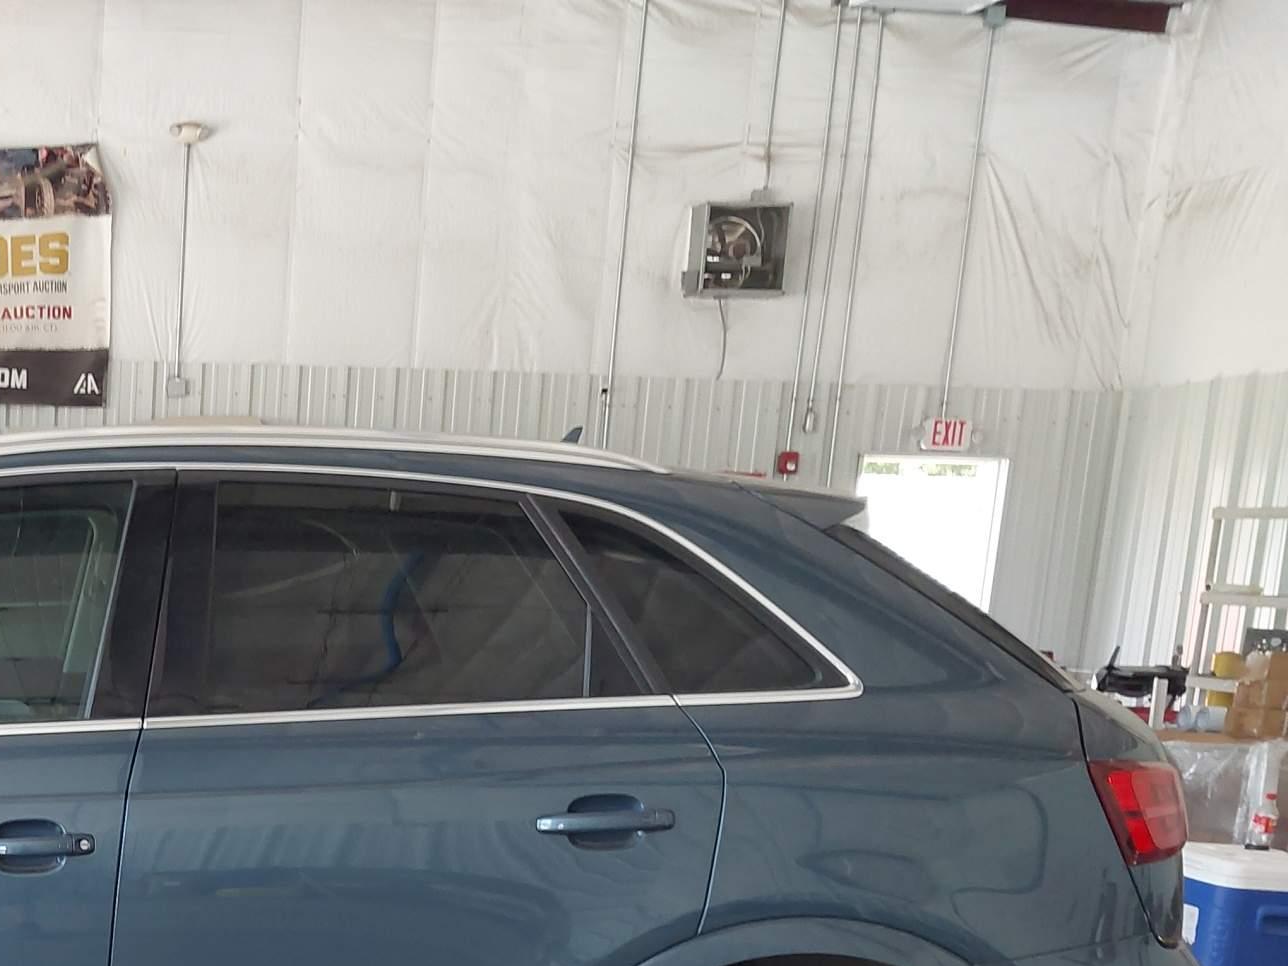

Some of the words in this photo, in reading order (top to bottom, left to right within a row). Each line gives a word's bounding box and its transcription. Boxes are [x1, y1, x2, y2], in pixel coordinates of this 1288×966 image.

[33, 279, 67, 294] AUCTION
[1, 305, 72, 321] AUCTION
[931, 420, 967, 446] EXIT
